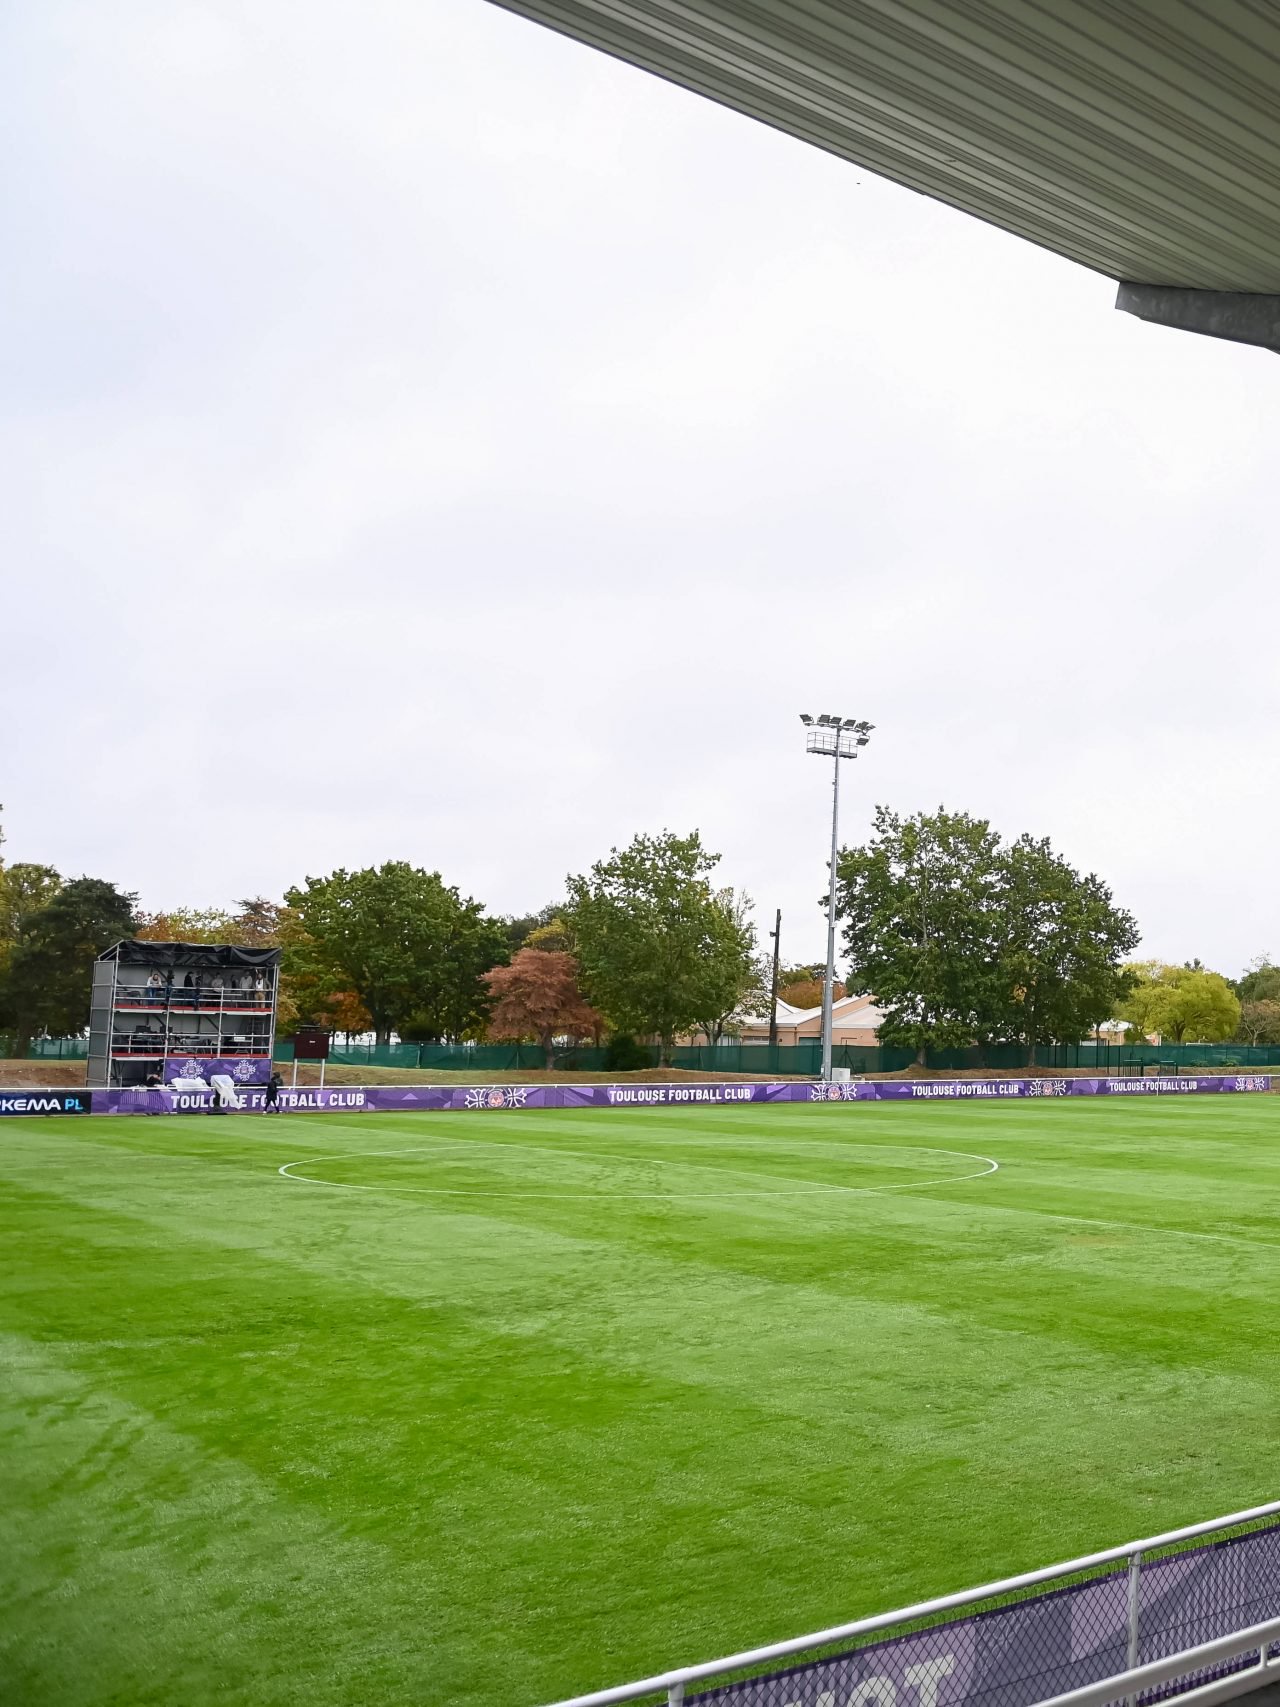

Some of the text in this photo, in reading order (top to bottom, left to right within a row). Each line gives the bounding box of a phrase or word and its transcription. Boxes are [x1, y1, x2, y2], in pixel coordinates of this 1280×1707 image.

[912, 1084, 1019, 1096] TOULOUSE FOOTBALL CLUB
[1110, 1080, 1197, 1091] TOULOUSE FOOTBALL CLUB
[329, 1093, 365, 1106] CLUB
[610, 1088, 751, 1102] TOULOUSE FOOTBALL CLUB
[0, 1098, 62, 1111] KEMA
